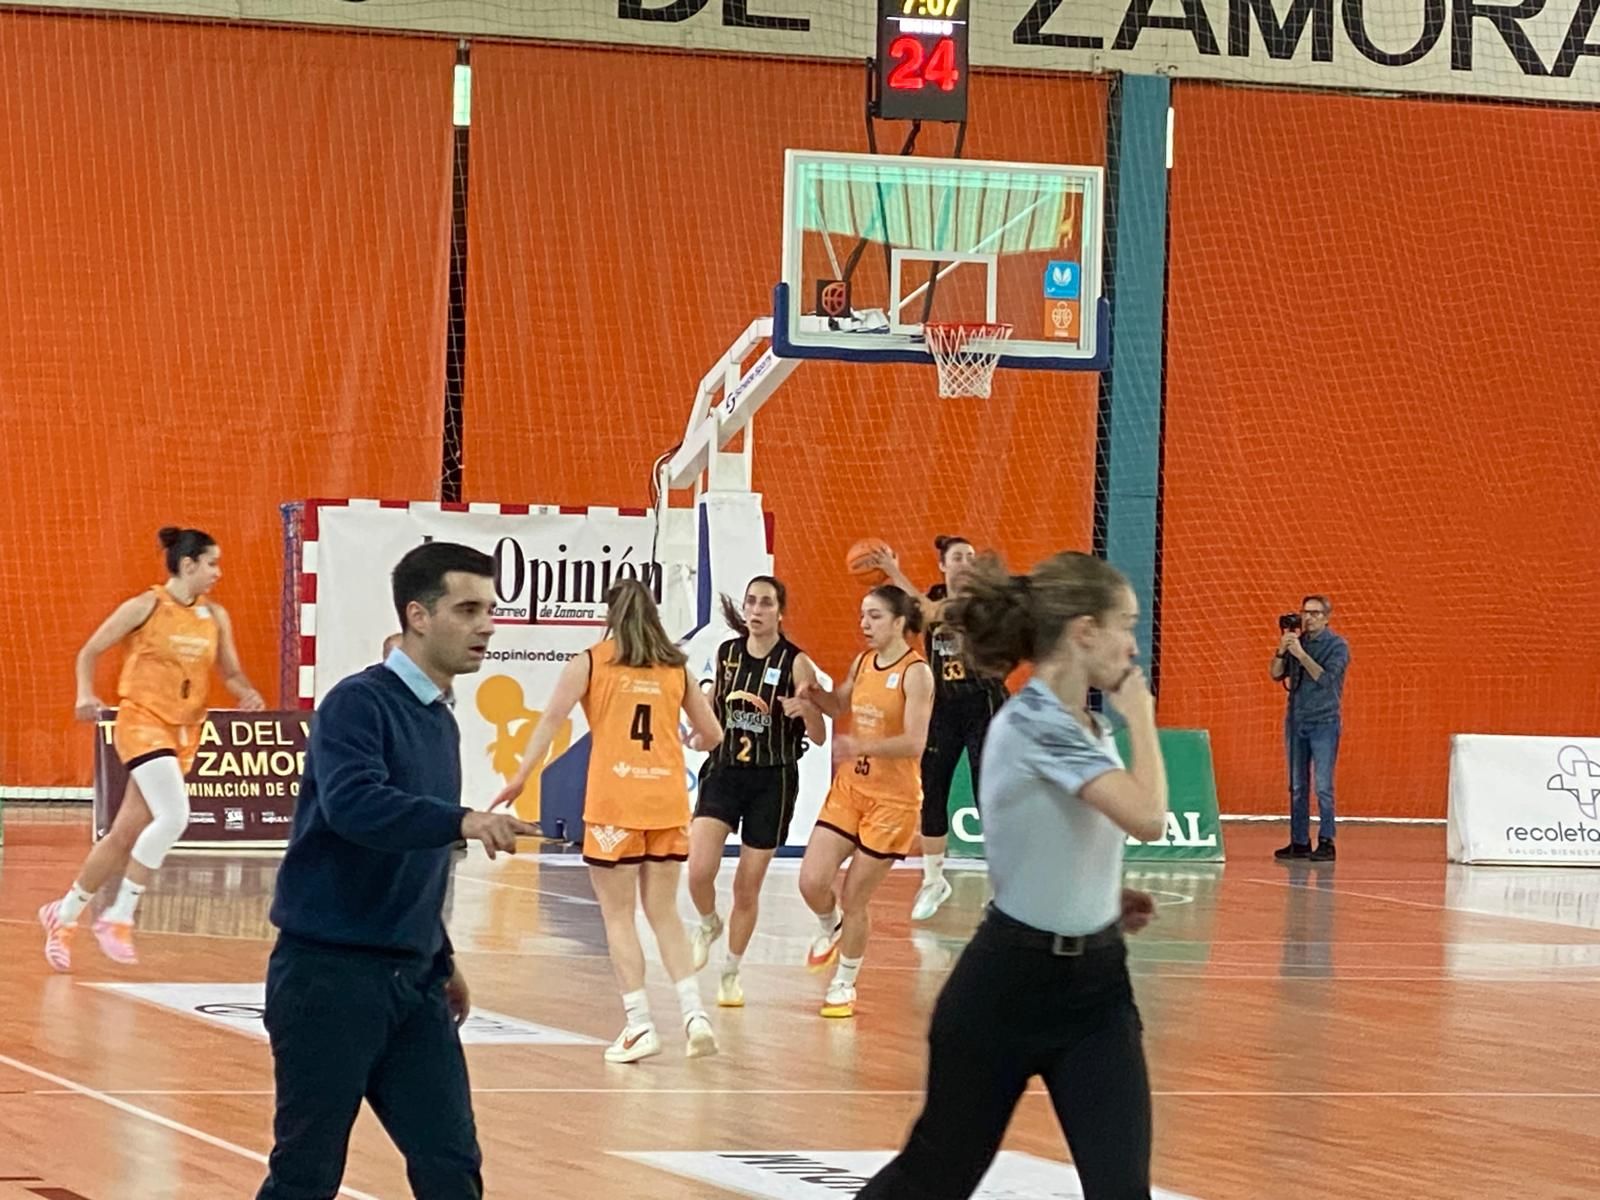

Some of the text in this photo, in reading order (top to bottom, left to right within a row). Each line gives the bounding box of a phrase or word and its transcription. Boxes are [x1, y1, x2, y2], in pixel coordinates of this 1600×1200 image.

[888, 36, 959, 91] 24
[231, 722, 294, 746] DEL
[630, 704, 653, 751] 4
[736, 736, 752, 762] 2
[265, 782, 285, 797] DE
